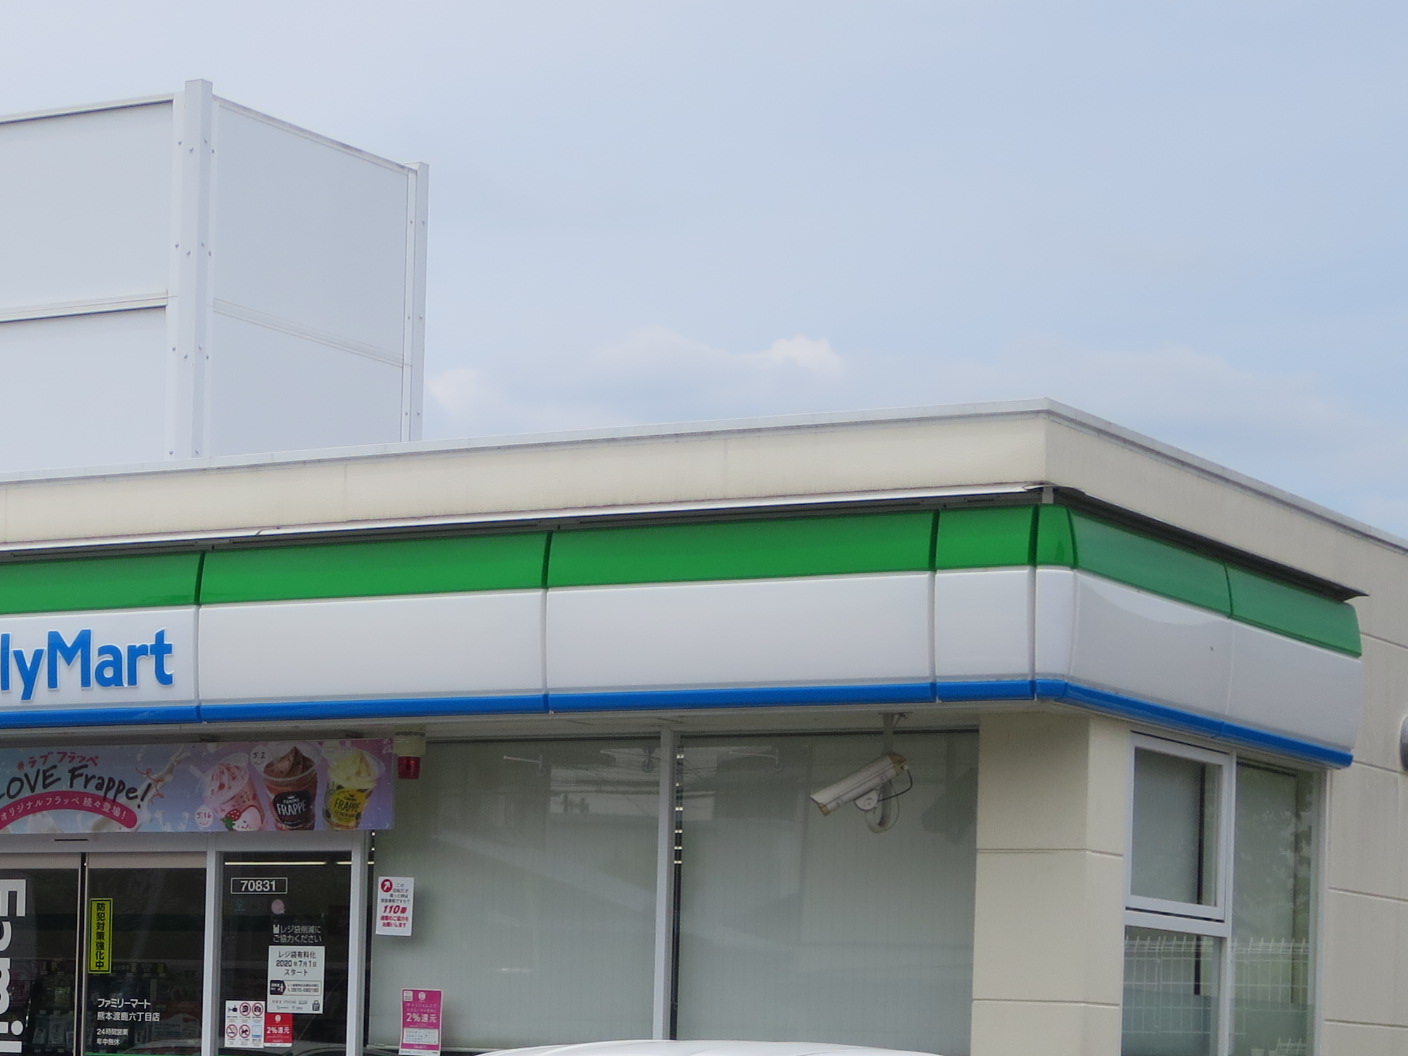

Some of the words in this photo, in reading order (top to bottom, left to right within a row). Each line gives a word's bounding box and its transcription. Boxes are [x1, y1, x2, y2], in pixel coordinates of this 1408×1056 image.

[240, 880, 276, 891] 70831
[95, 902, 105, 969] 防犯対策強化中
[272, 934, 322, 942] ご協力ください
[278, 951, 316, 959] レジ袋有料化
[97, 998, 151, 1009] ファミリーマート
[96, 1011, 160, 1022] 熊本渡鹿六丁目店
[406, 1013, 437, 1023] 2%還元
